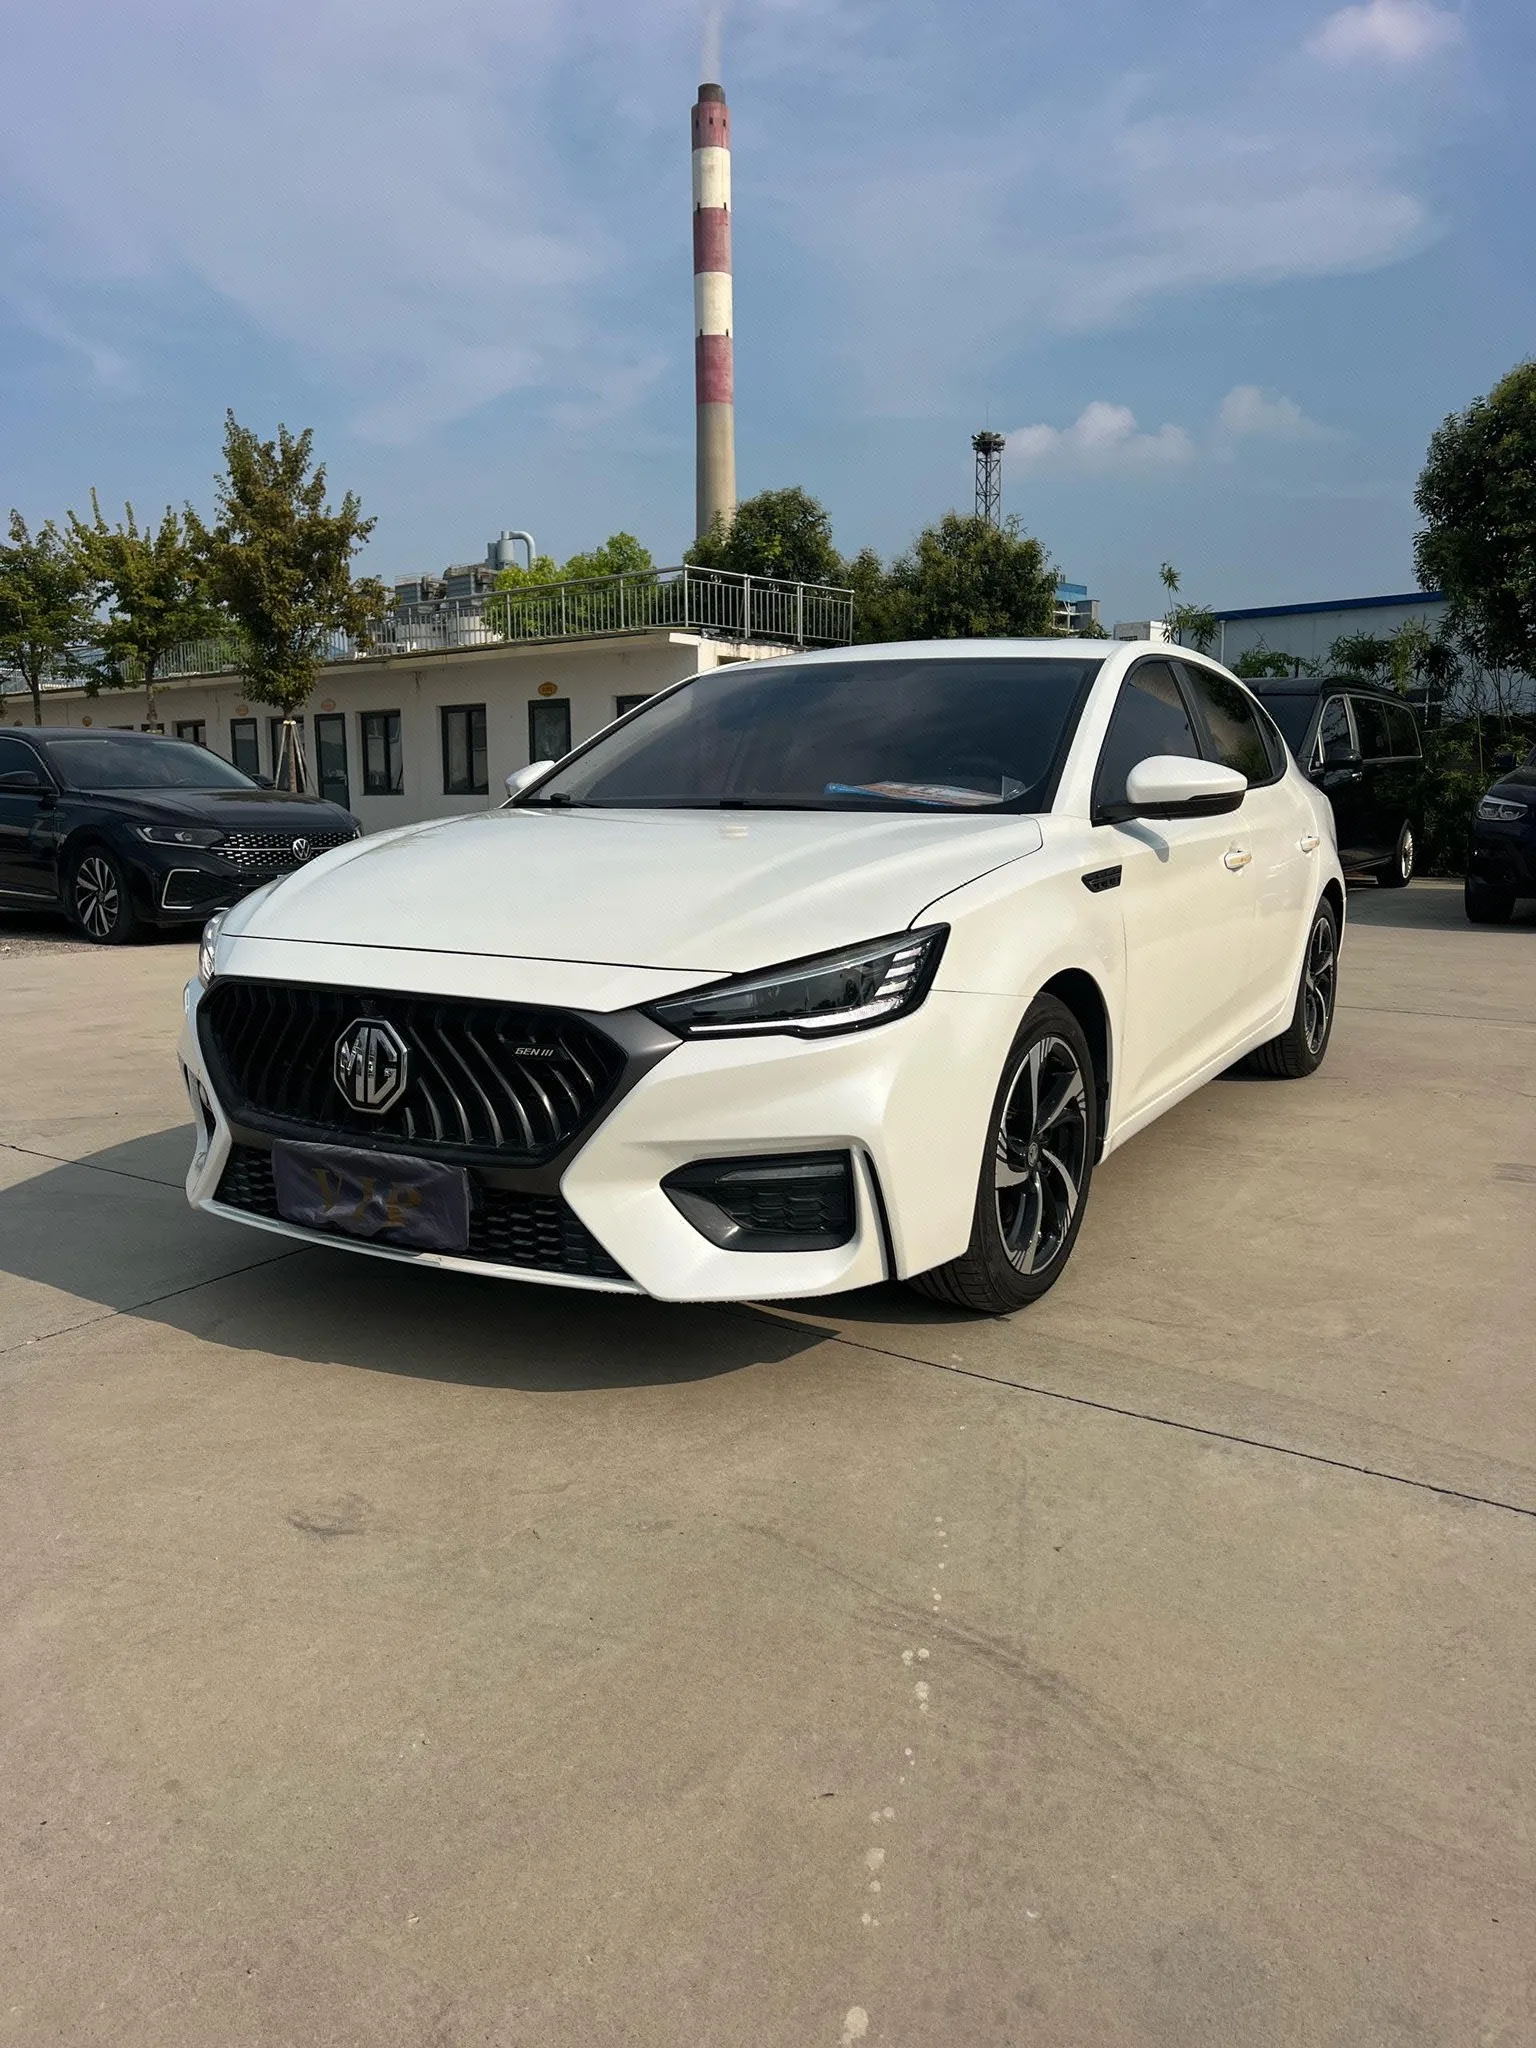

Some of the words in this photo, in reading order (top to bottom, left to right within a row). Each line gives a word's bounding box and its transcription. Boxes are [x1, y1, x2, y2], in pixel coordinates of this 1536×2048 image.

[337, 1023, 402, 1108] MG
[514, 1047, 541, 1056] GEN
[312, 1167, 424, 1228] VIP
